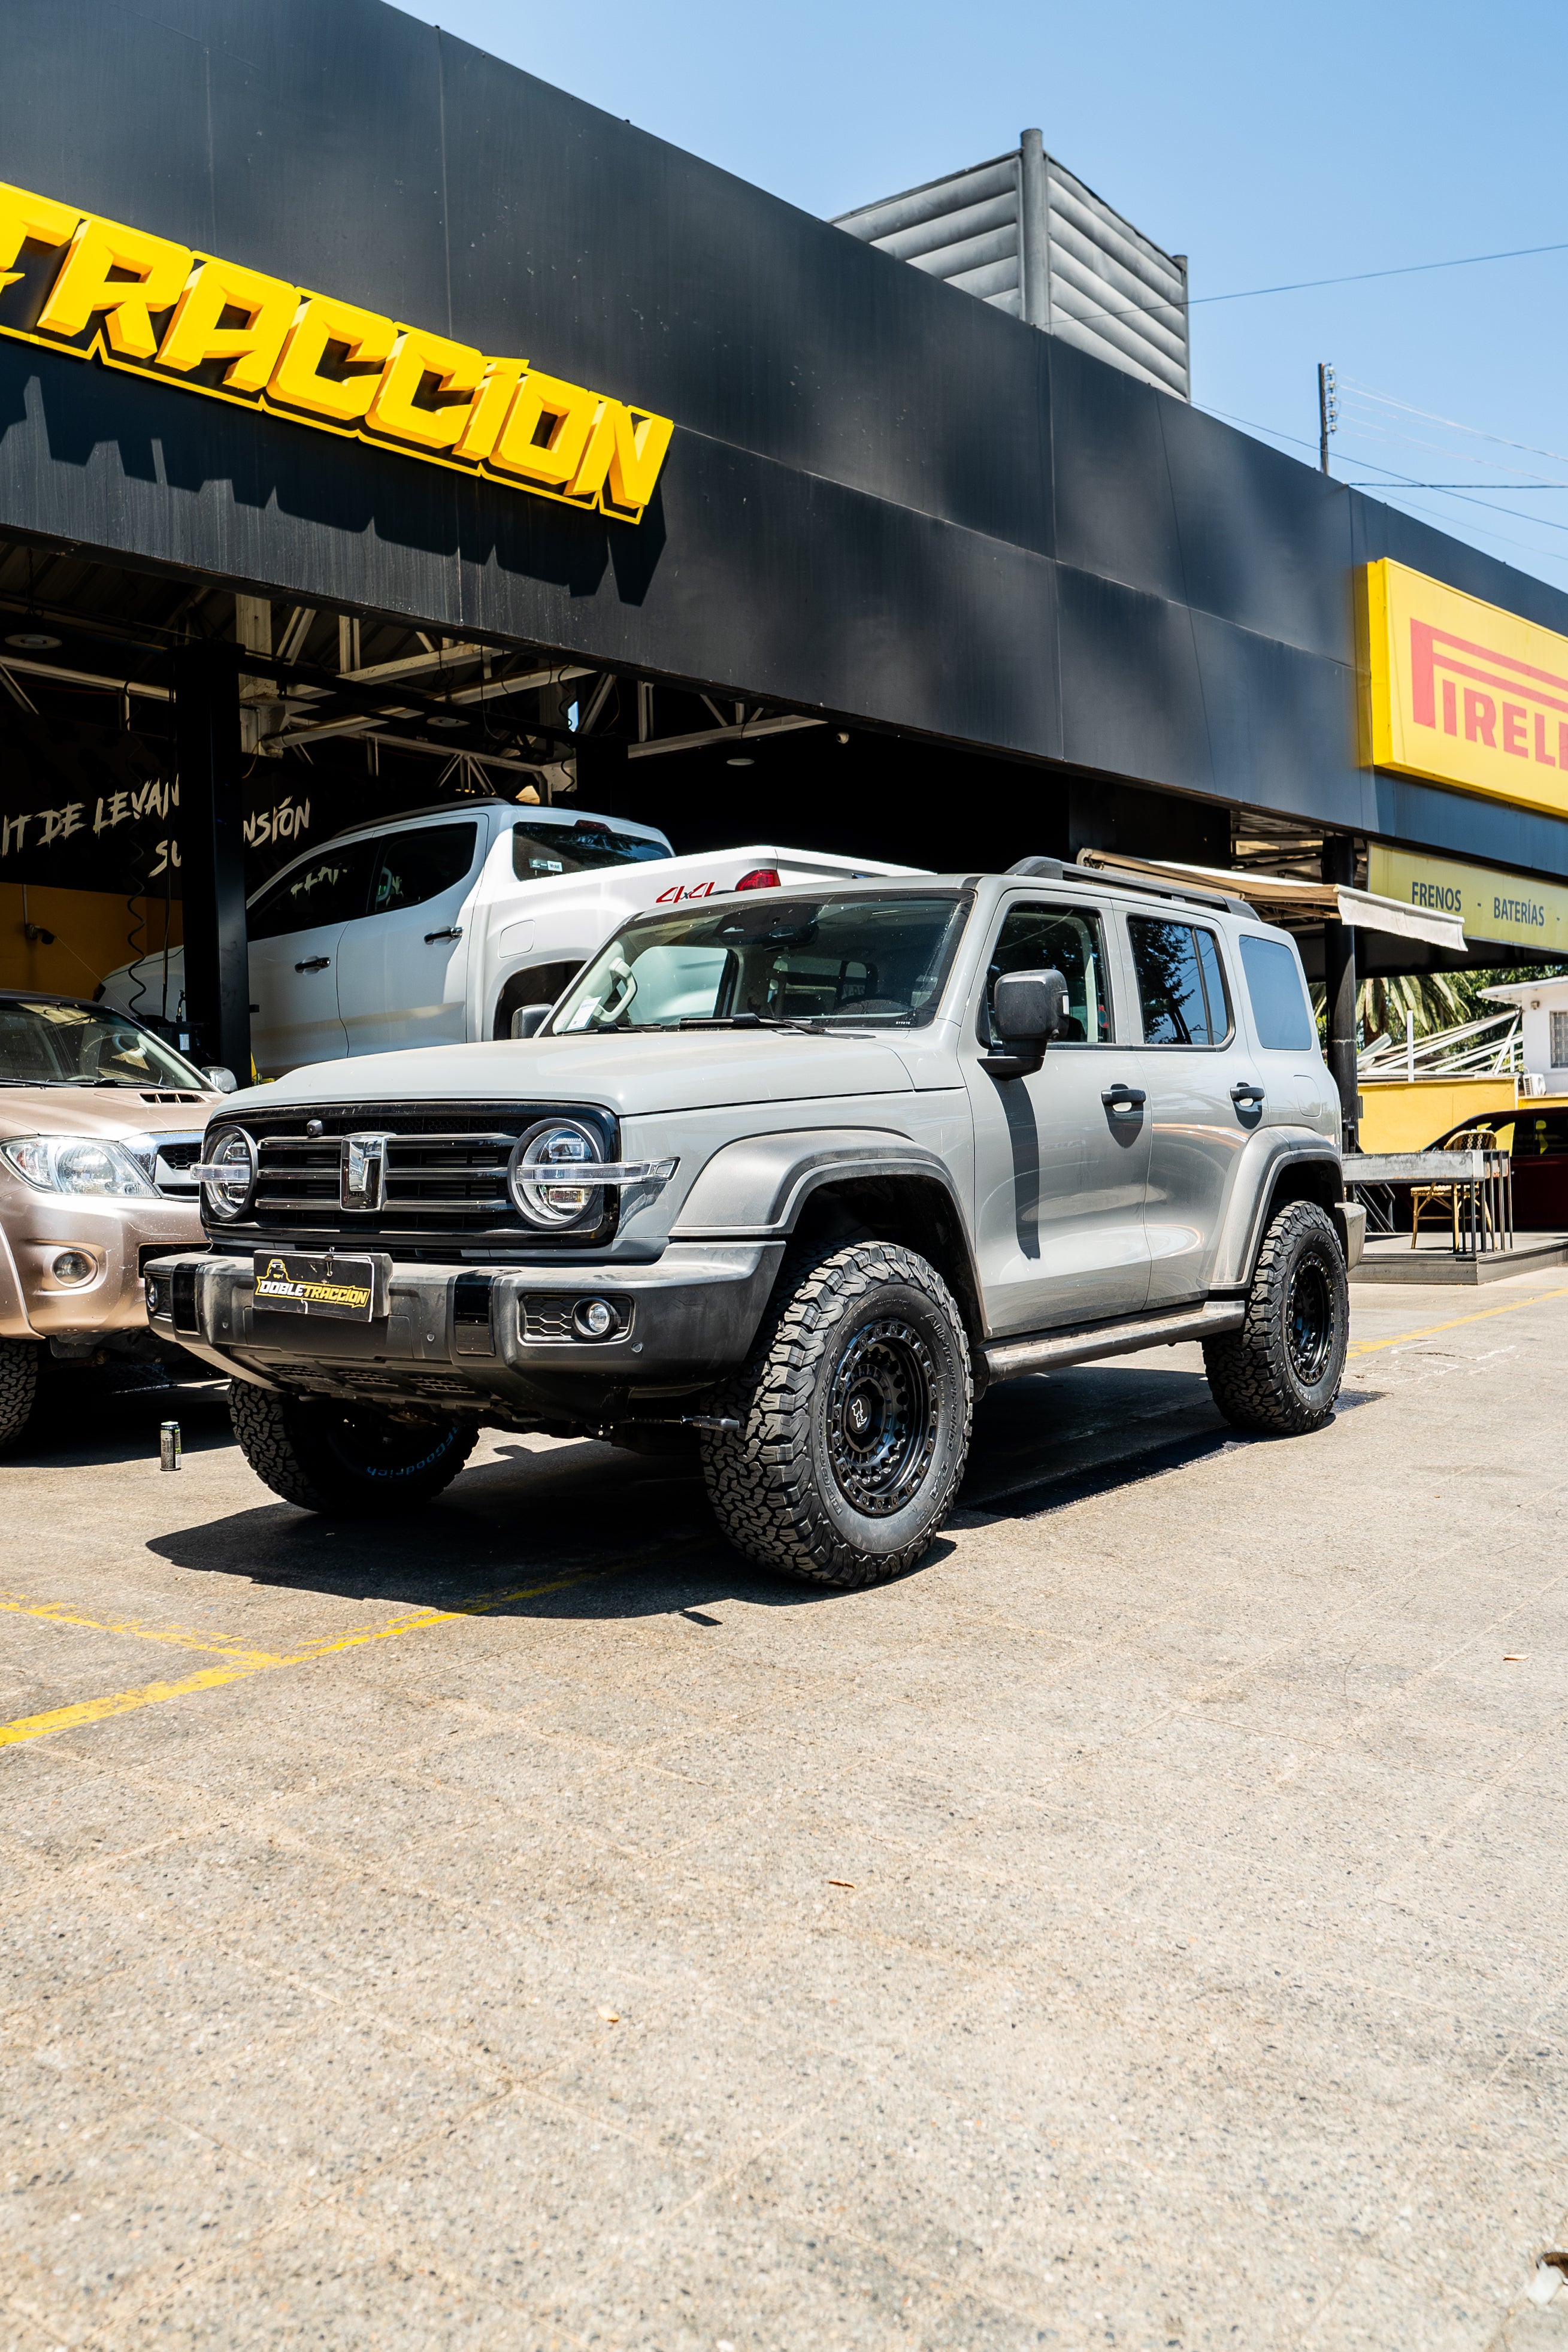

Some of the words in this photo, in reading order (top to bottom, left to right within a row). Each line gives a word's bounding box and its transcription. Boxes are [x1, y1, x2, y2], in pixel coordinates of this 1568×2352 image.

[35, 801, 87, 848] DE
[655, 882, 715, 903] 4x4
[1412, 881, 1461, 912] FRENOS
[1494, 897, 1545, 926] BATERÍAS
